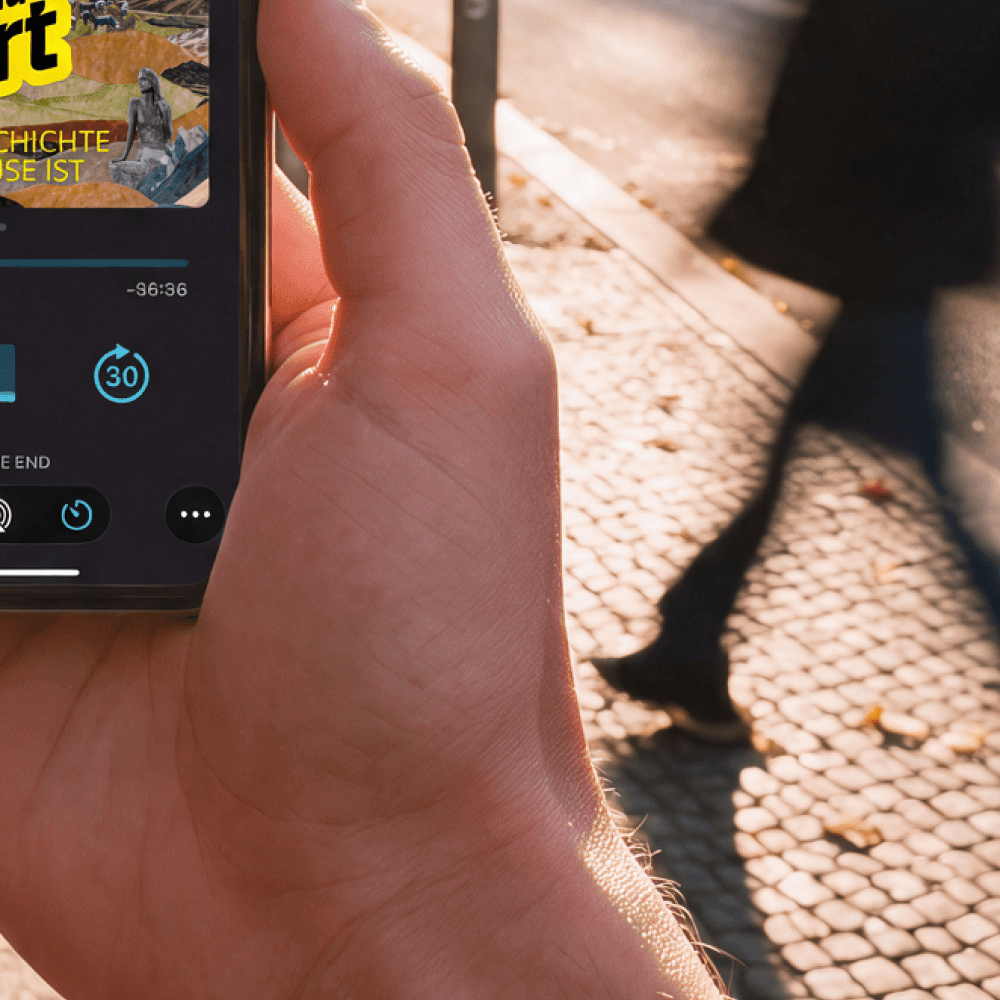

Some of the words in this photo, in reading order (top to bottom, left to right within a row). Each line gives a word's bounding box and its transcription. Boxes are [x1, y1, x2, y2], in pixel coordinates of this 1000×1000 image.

[45, 158, 86, 183] IST
[105, 366, 138, 388] 30
[14, 454, 51, 470] END
